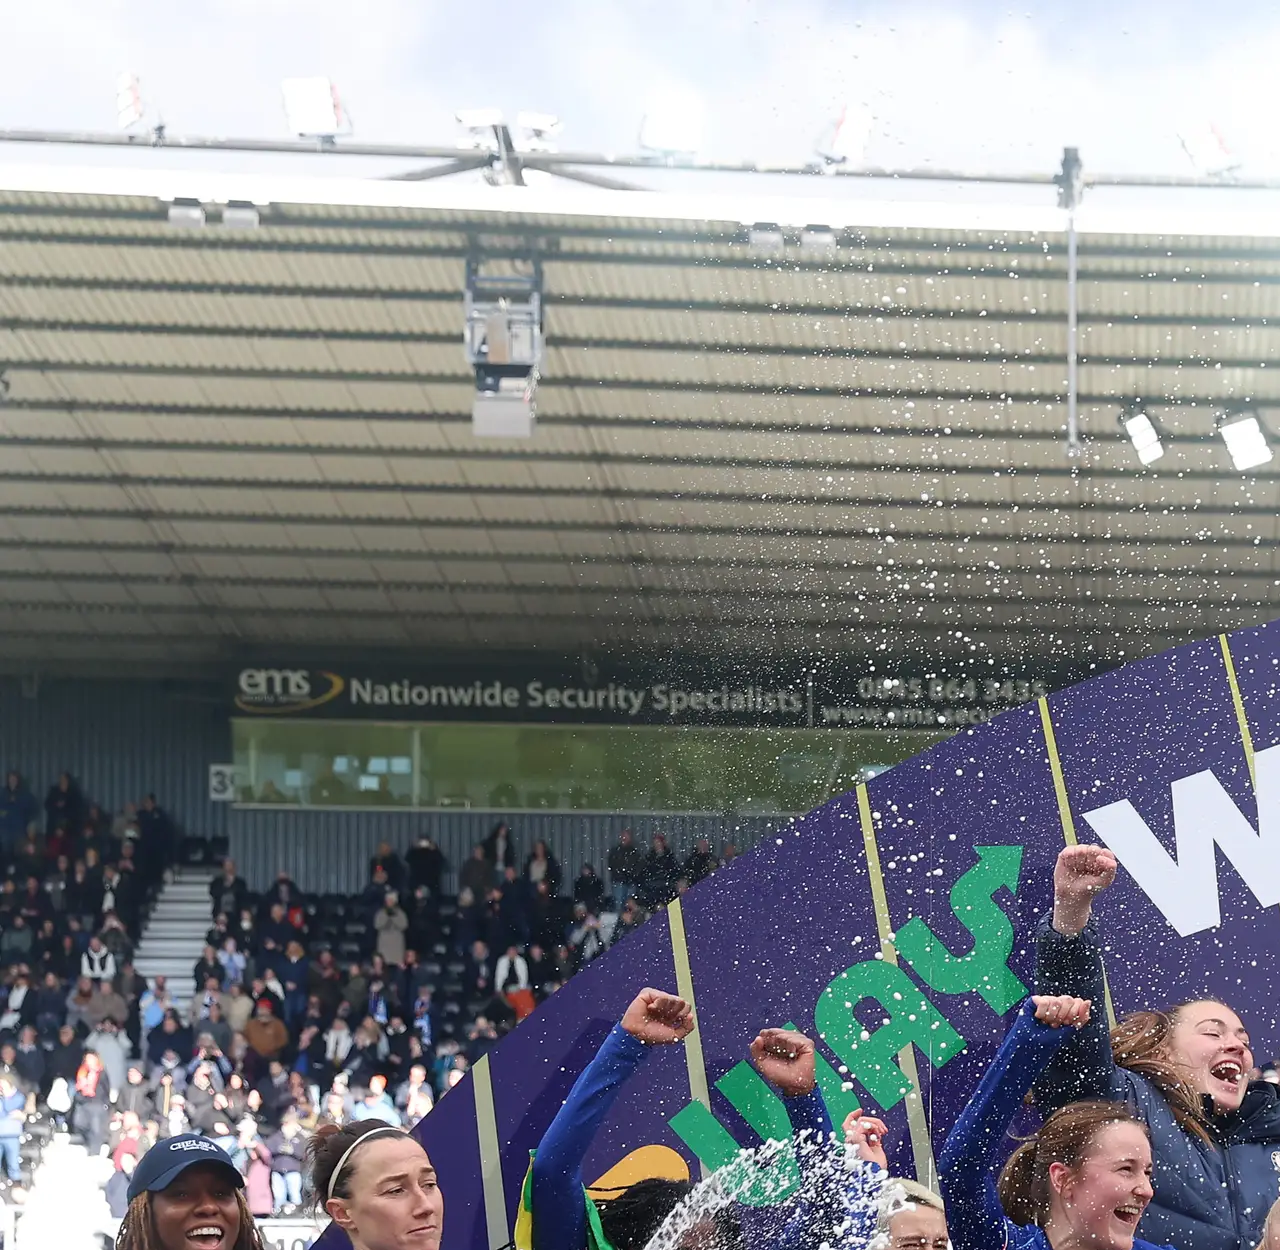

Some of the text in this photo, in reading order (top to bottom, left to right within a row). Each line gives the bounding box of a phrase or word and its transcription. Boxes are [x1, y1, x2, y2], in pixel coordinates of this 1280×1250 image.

[239, 668, 311, 696] ems
[351, 678, 801, 715] Nationwide Security Specialists
[585, 845, 1029, 1210] WAY
[170, 1140, 218, 1152] CHELSEA
